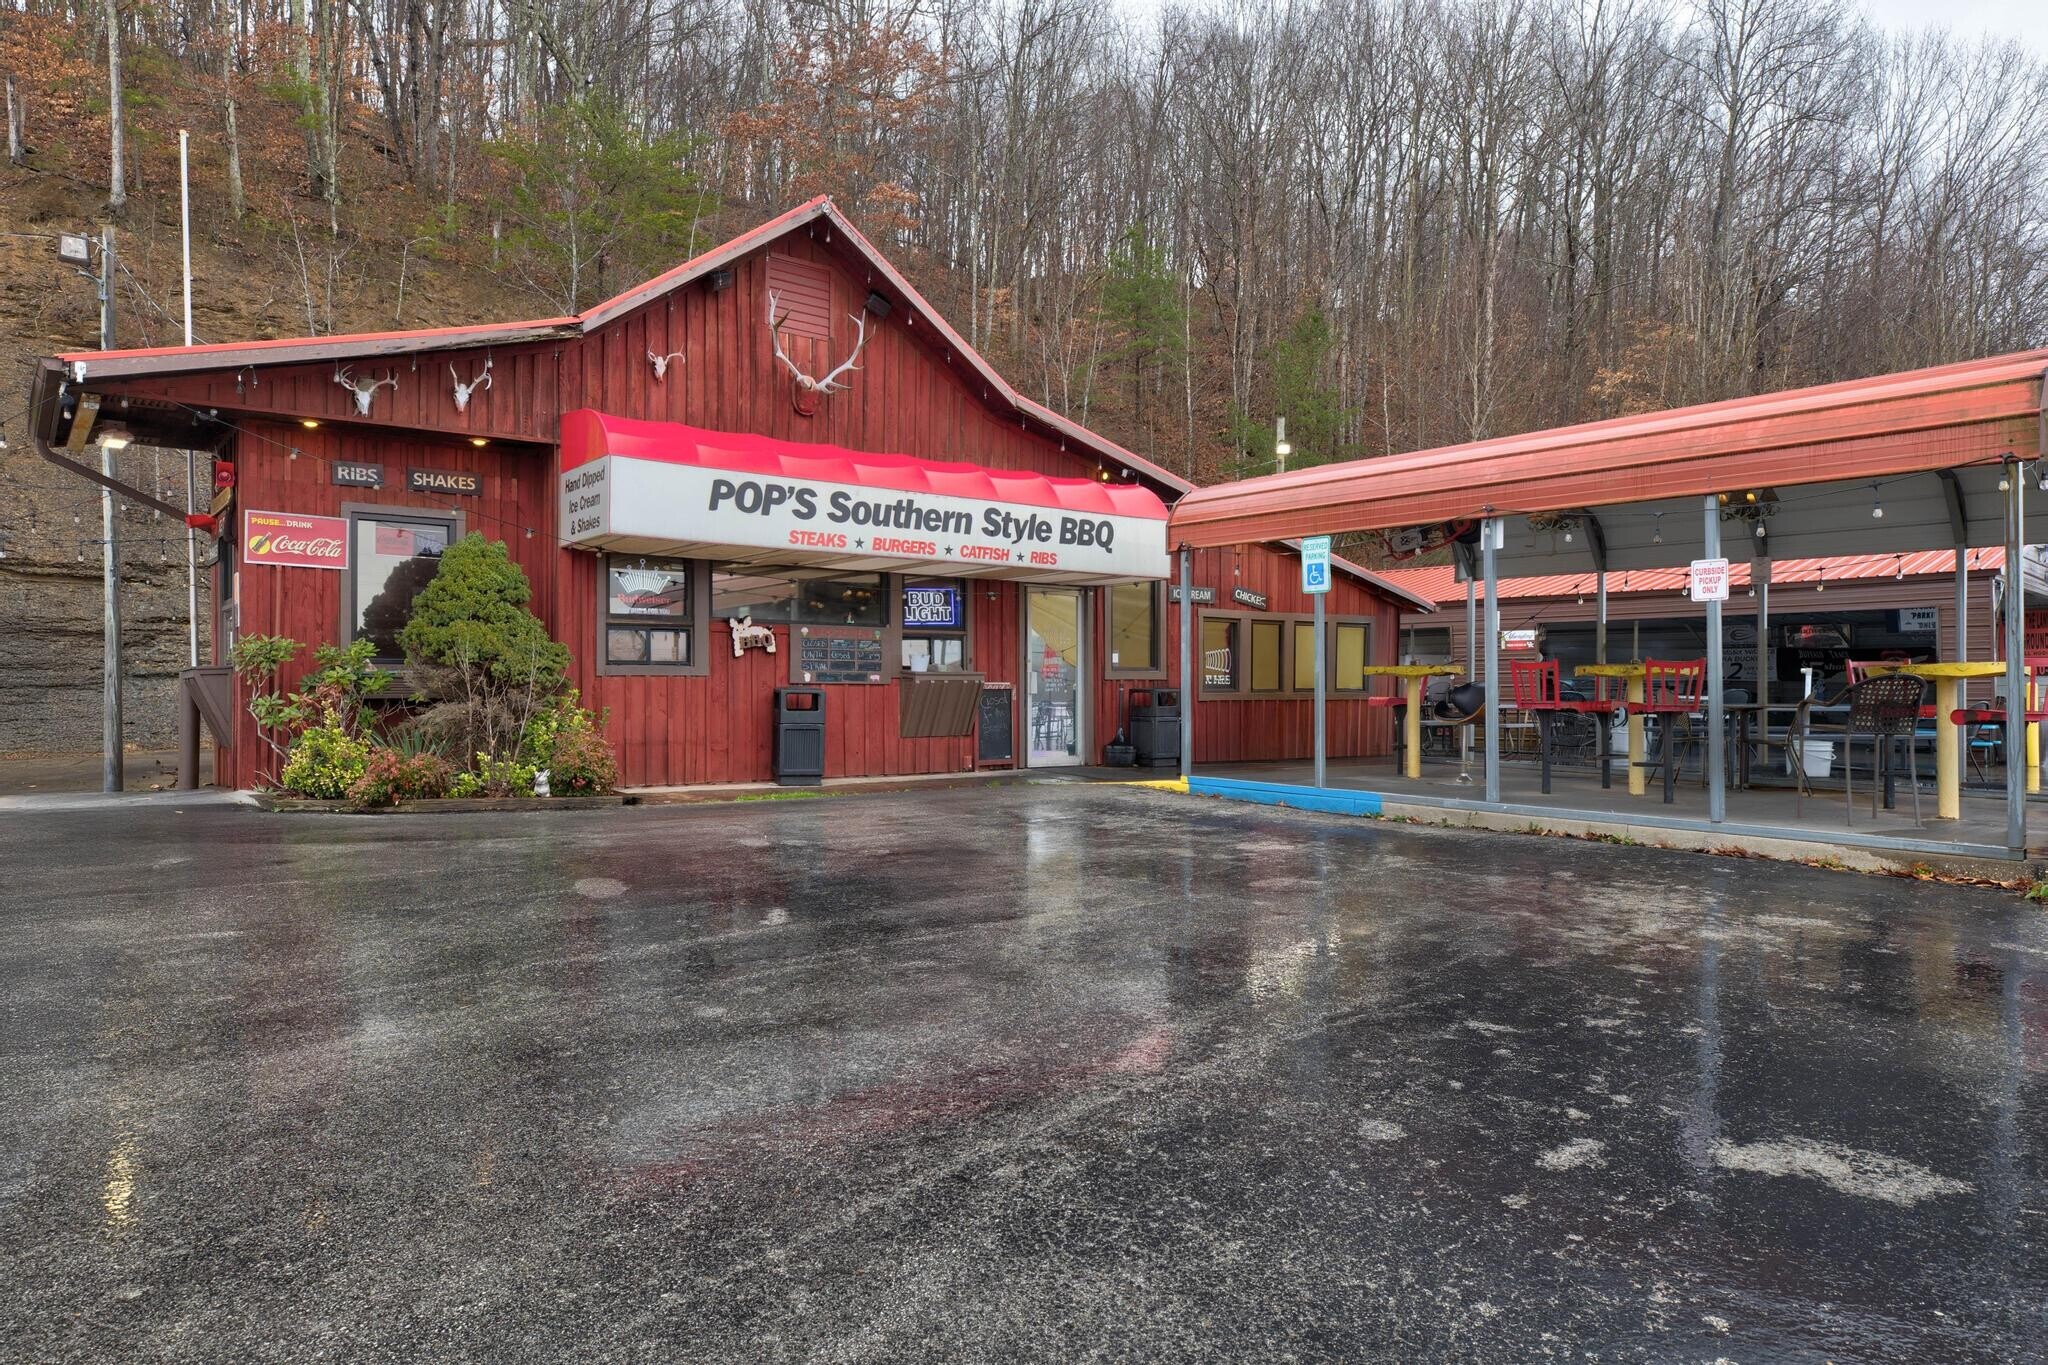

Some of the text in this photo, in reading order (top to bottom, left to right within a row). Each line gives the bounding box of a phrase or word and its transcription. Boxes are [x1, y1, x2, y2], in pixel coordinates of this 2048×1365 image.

[337, 466, 378, 482] RIBS
[413, 472, 476, 490] SHAKES
[565, 465, 606, 494] Hand Dipped
[568, 493, 601, 514] Ice Cream
[708, 478, 1115, 553] POP'S Southern Style BBQ
[570, 515, 601, 536] & Shakes
[271, 534, 342, 559] Coca-Cola
[788, 530, 1058, 565] STEAKS BURGERS CATFISH RIBS
[1304, 541, 1328, 550] RESERVED
[1305, 551, 1326, 560] PARKING
[1695, 566, 1725, 576] CURBSIDE
[1699, 576, 1721, 585] PICKUP
[1190, 590, 1211, 600] REAM
[1702, 585, 1719, 594] ONLY
[617, 592, 672, 604] Budweiser
[908, 591, 944, 606] BUD
[659, 608, 671, 616] YOU
[739, 634, 773, 650] BBQ
